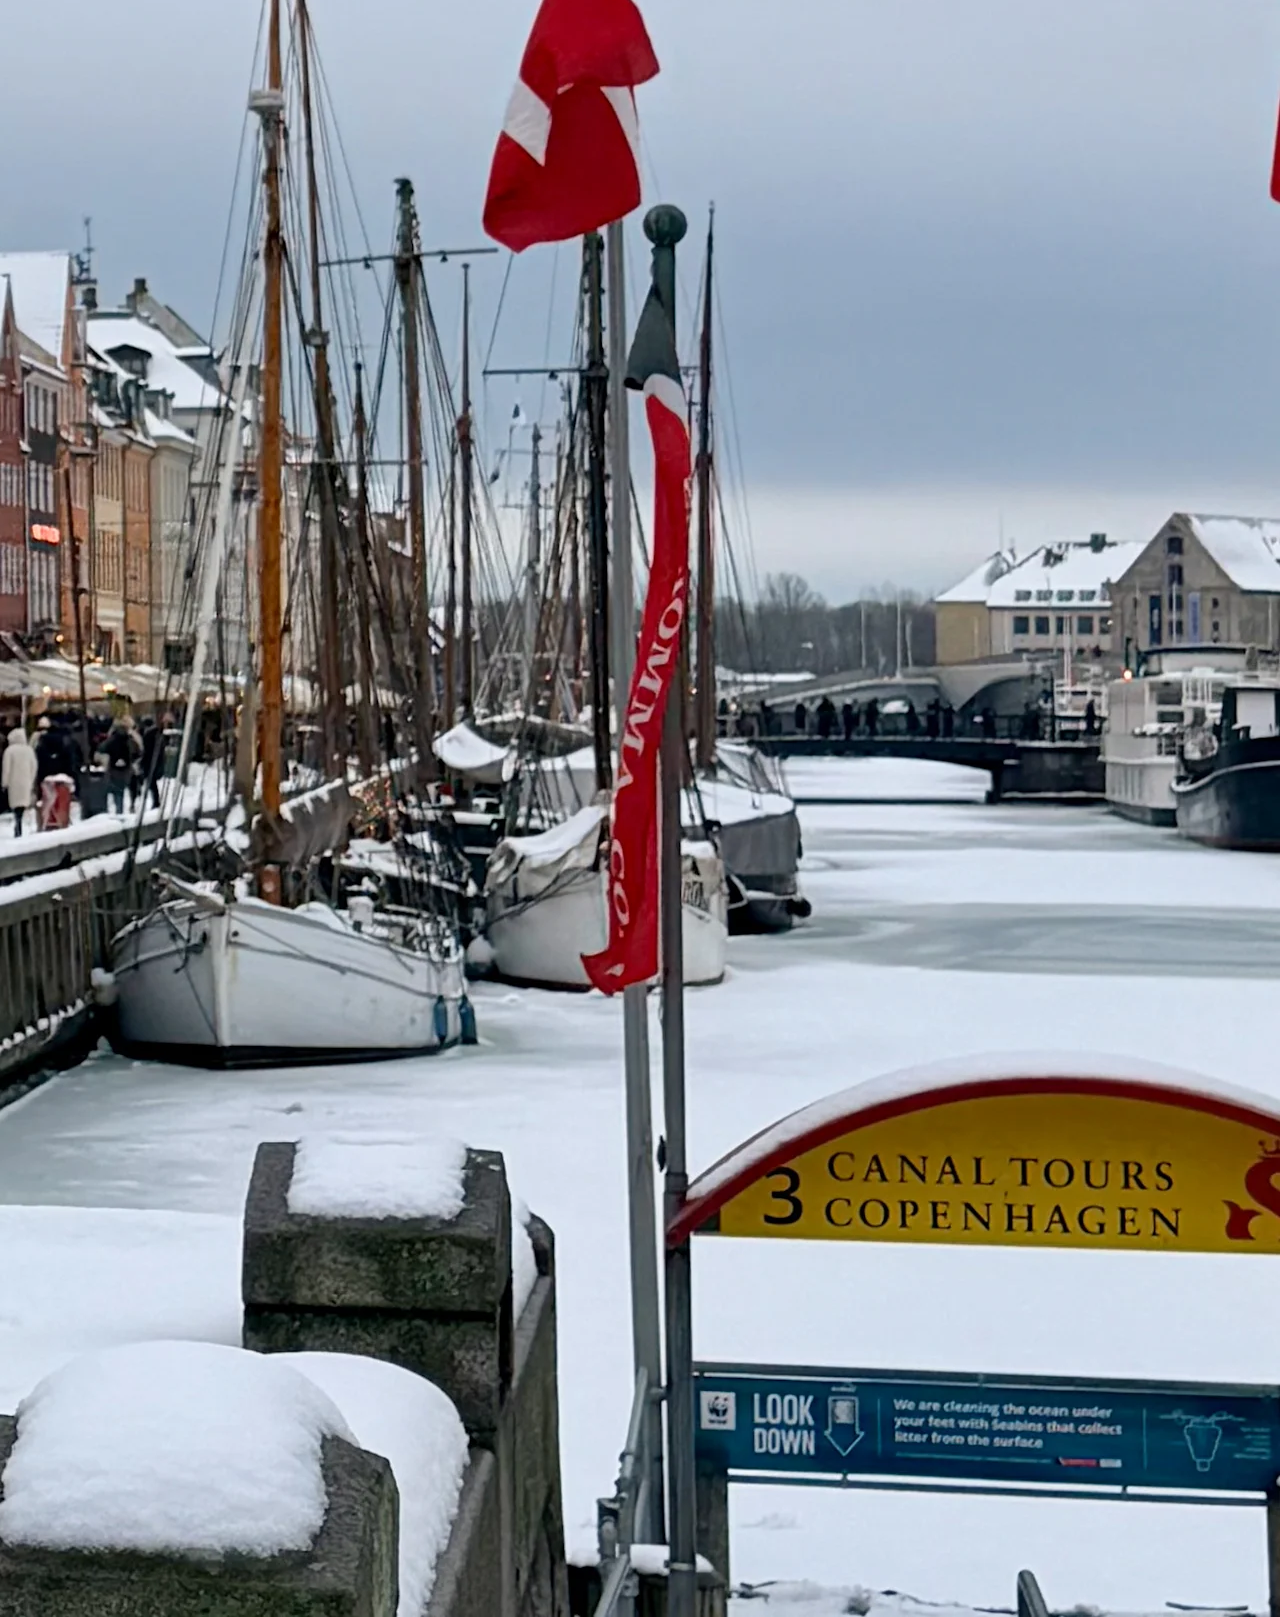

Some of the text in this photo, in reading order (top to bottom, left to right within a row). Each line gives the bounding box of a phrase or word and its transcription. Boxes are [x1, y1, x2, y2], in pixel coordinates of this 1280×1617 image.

[828, 1152, 1175, 1192] CANAL TOURS
[762, 1166, 804, 1226] 3
[824, 1197, 1182, 1237] COPENHAGEN
[753, 1392, 815, 1426] LOOK
[893, 1398, 1113, 1419] We are cleaning the ocean under
[894, 1416, 1123, 1435] your feet with Seabins that collect
[894, 1430, 1044, 1449] litter from the surface
[753, 1427, 816, 1456] DOWN
